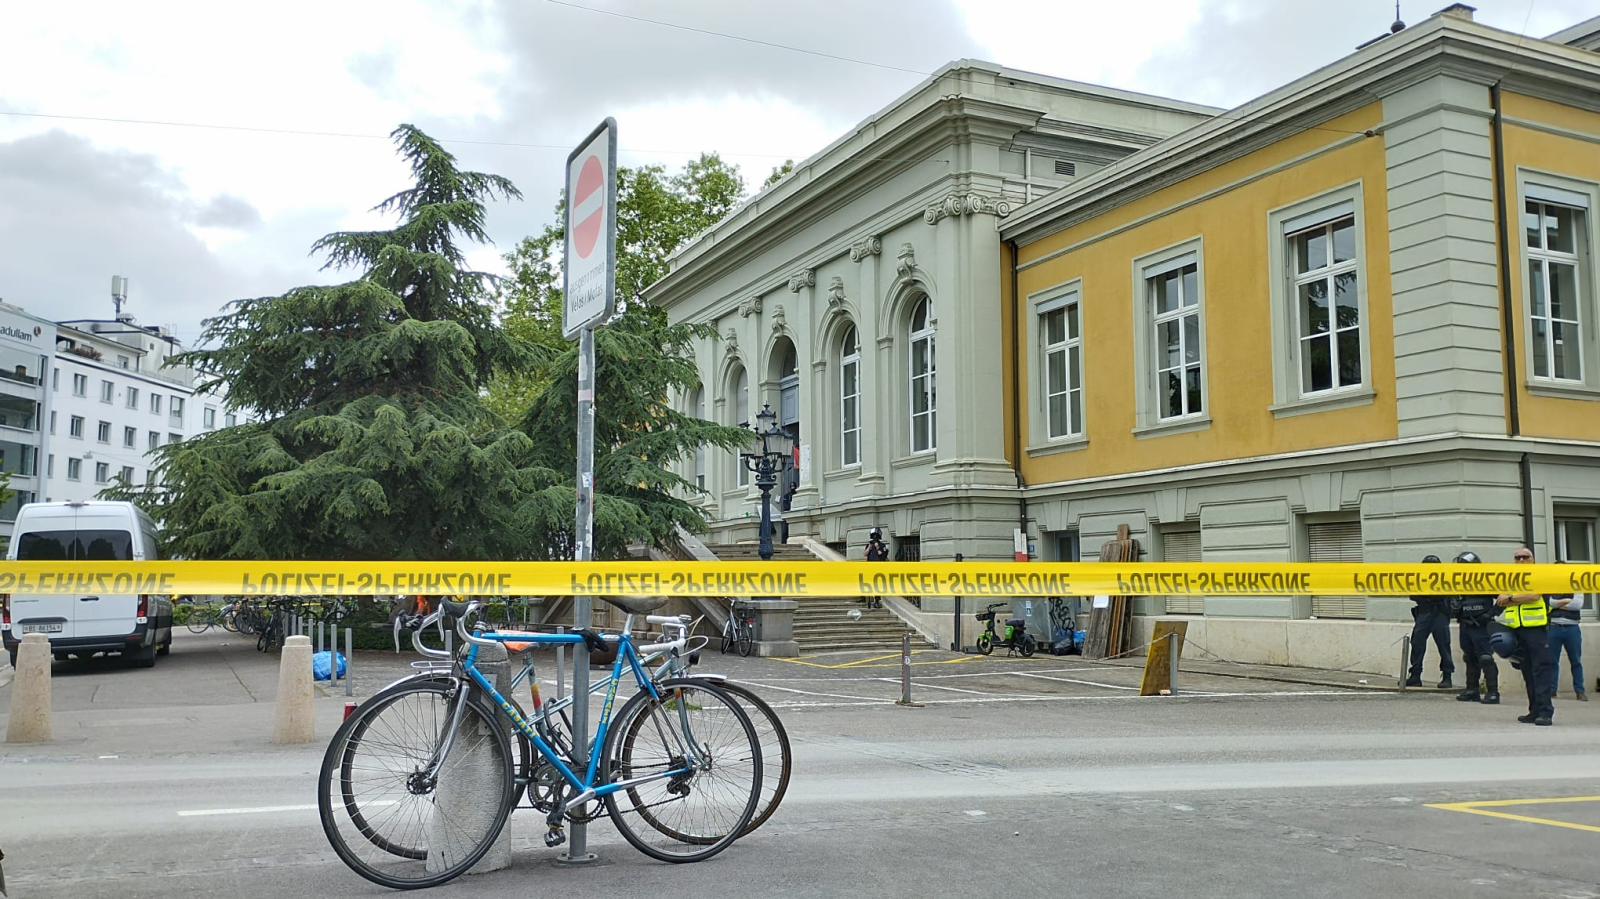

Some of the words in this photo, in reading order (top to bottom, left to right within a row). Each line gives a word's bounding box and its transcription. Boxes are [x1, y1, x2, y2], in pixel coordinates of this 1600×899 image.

[0, 326, 32, 342] adullam
[501, 701, 536, 738] CASATI
[602, 678, 619, 724] CASATI
